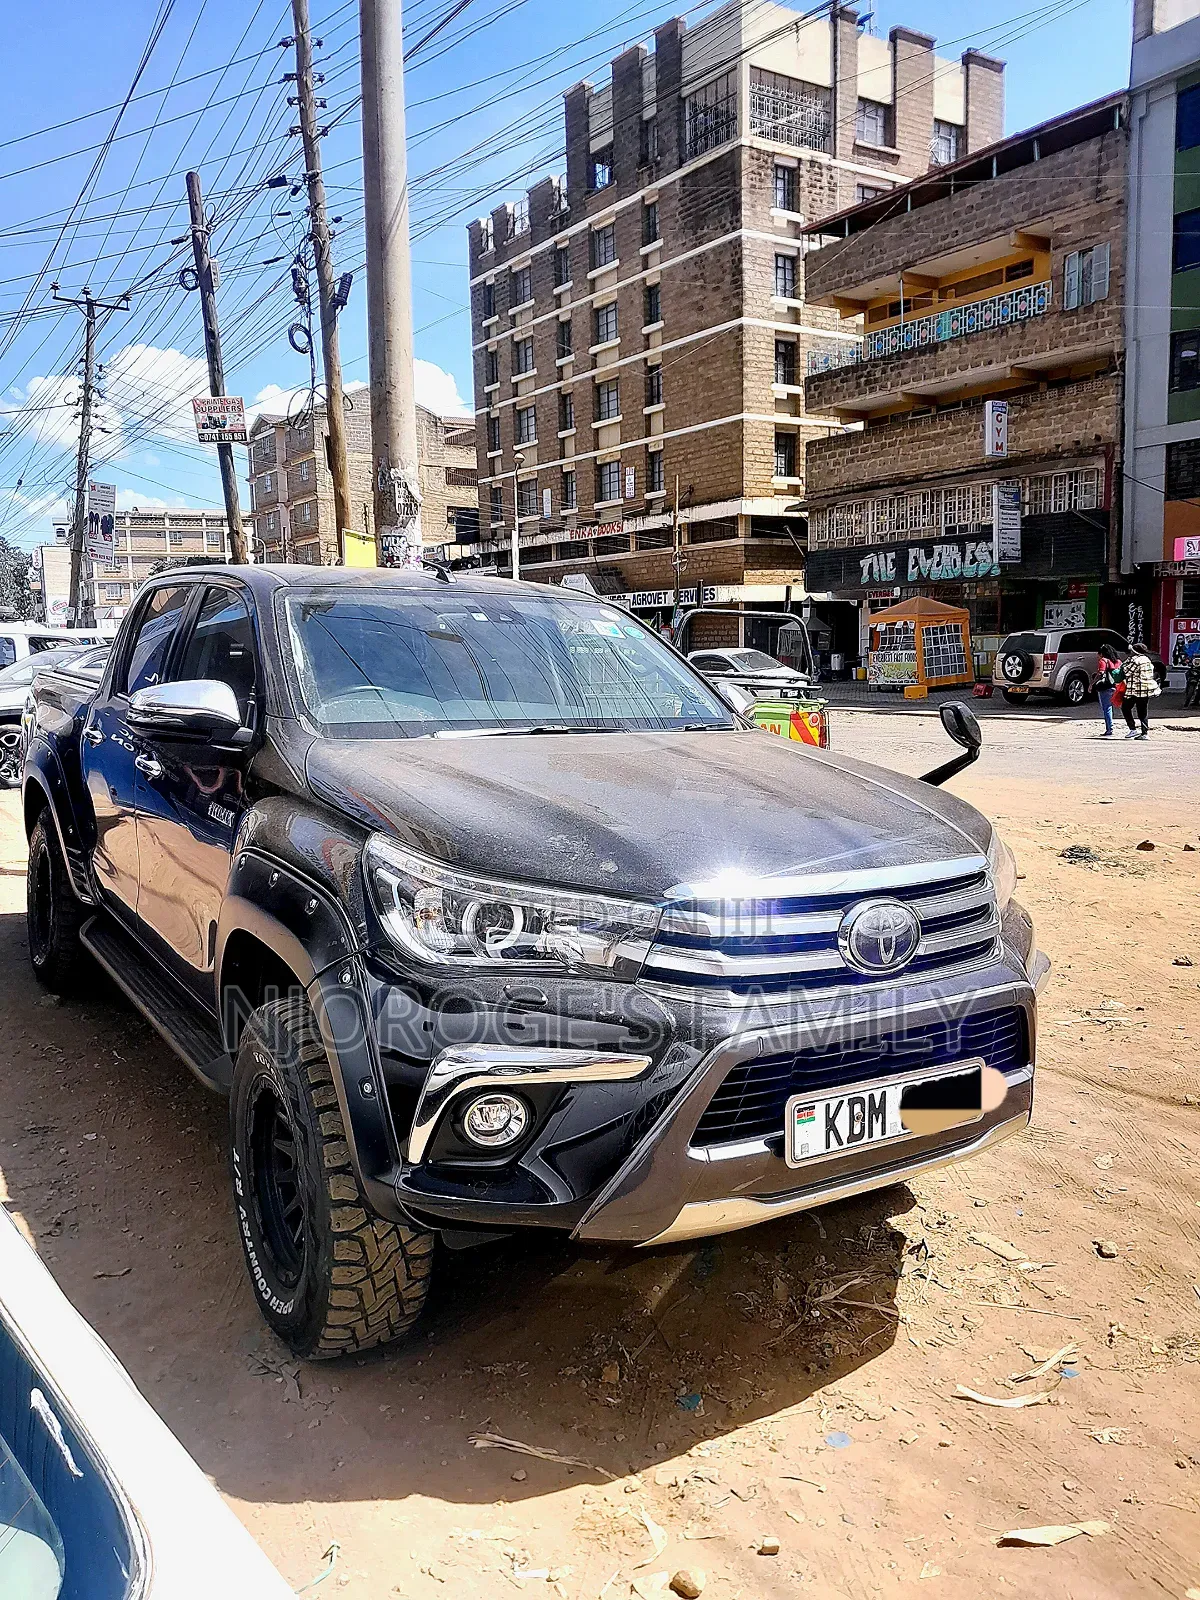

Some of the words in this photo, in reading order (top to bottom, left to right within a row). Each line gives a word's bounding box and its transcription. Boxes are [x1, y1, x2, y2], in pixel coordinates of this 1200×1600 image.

[632, 591, 668, 606] AGROVET
[673, 587, 715, 603] ERVIES
[825, 1090, 887, 1150] KDM
[239, 1205, 272, 1300] COUNTRY
